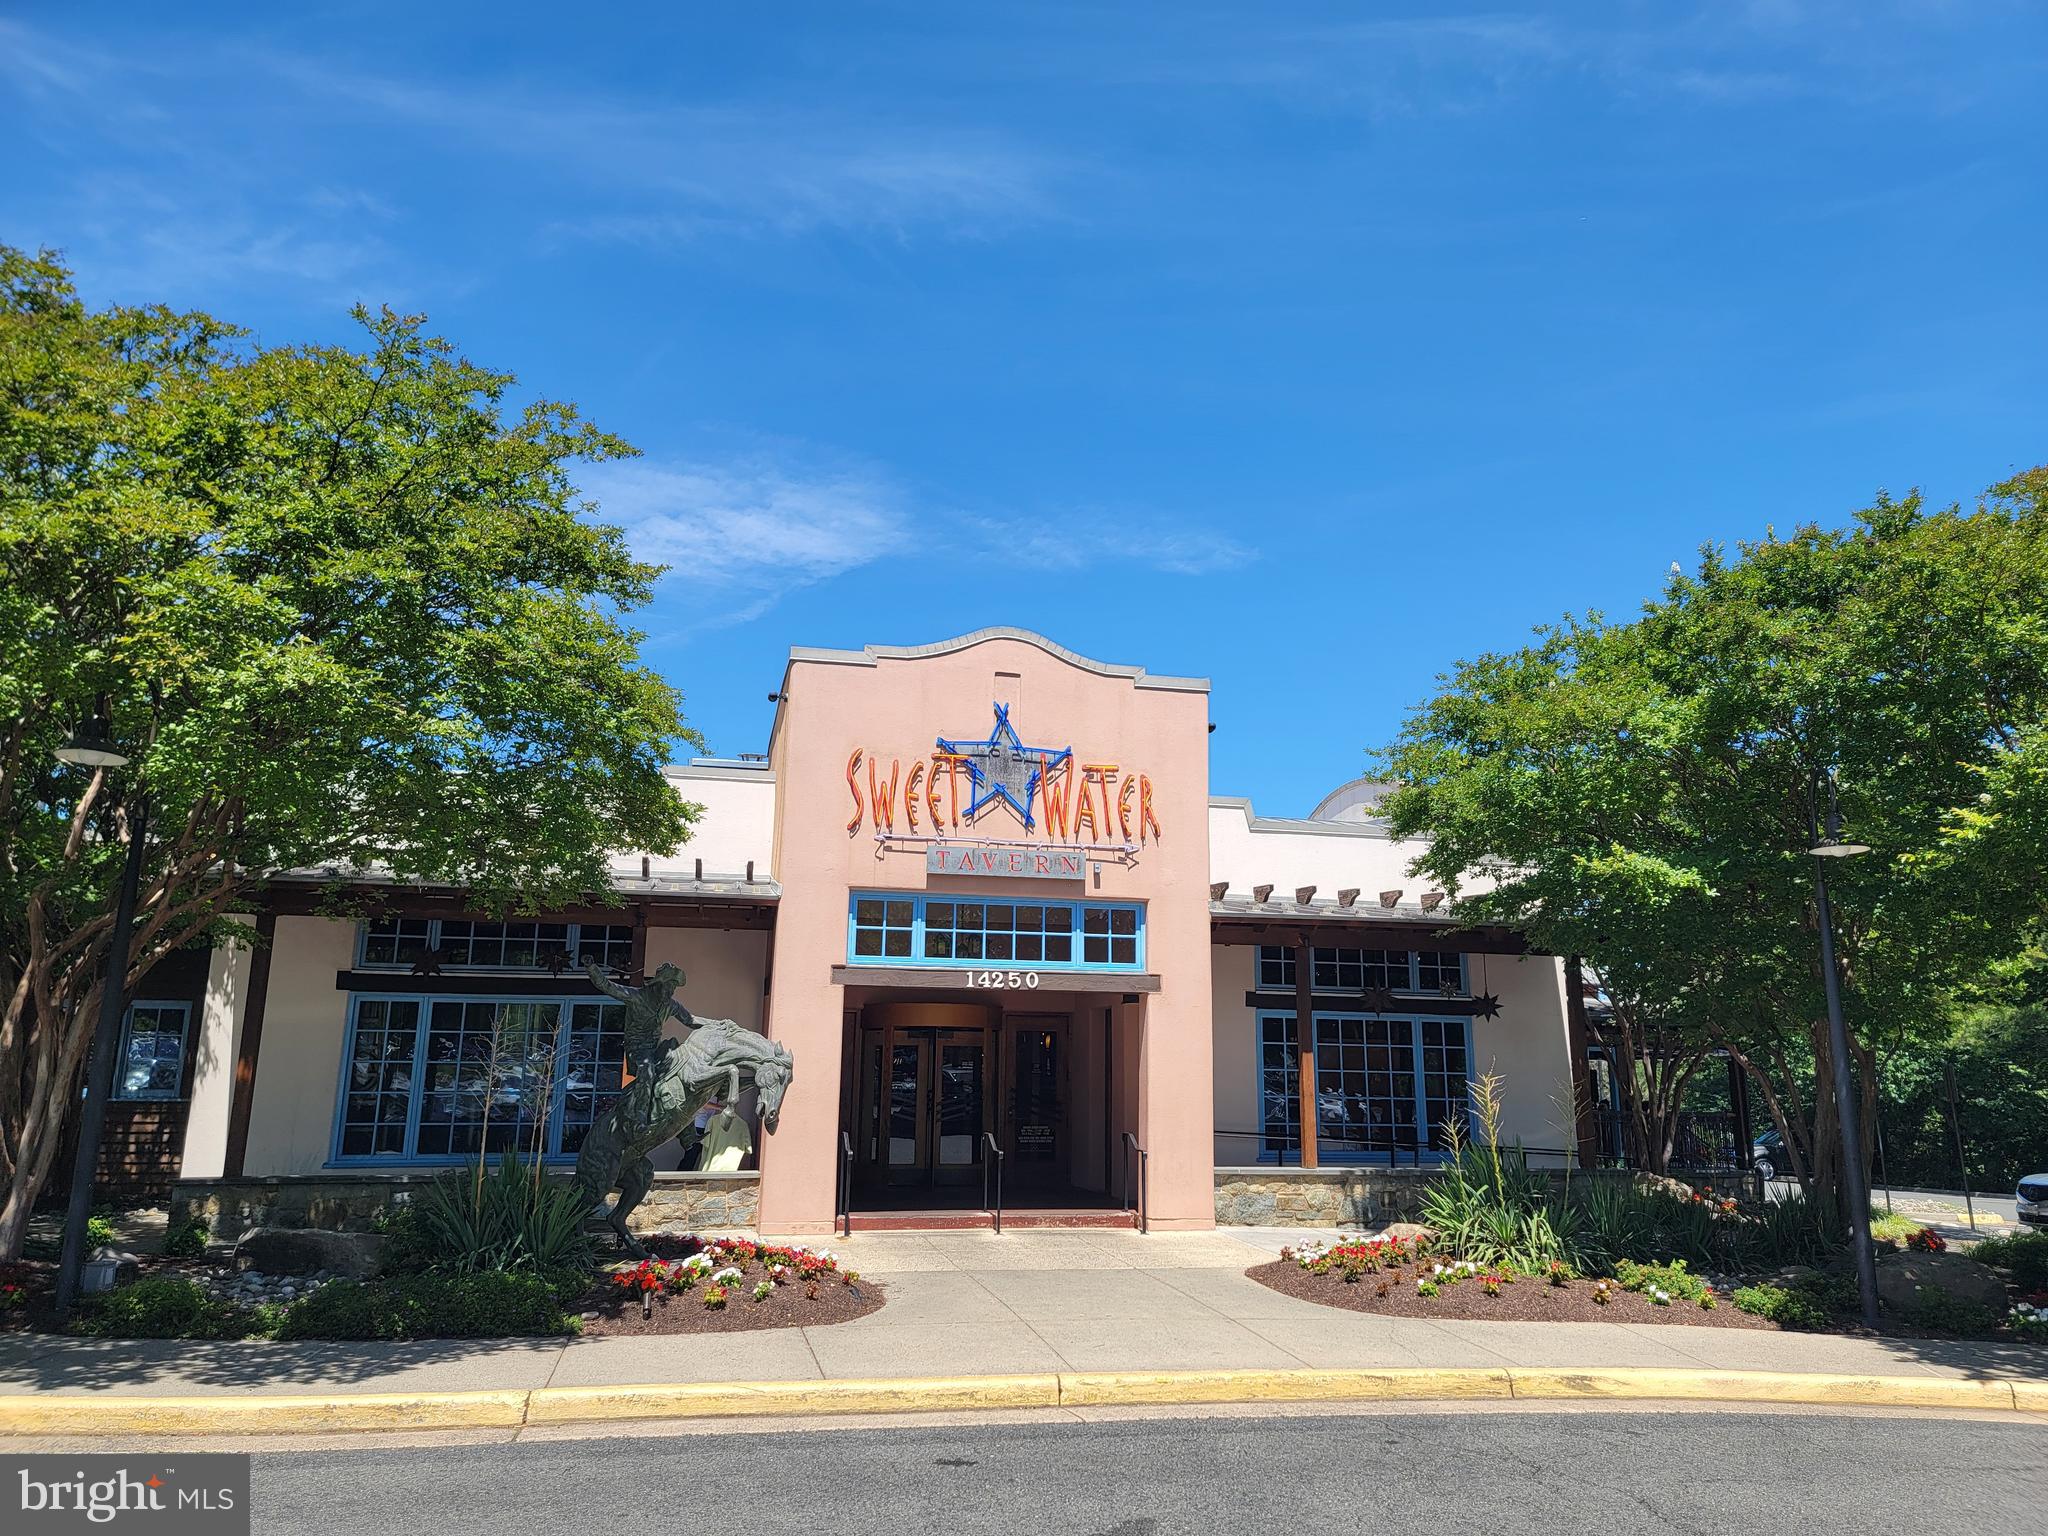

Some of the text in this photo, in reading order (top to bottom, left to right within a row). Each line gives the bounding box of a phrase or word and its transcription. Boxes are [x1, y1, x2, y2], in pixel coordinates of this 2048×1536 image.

[847, 748, 1161, 842] SWEET WATER
[935, 850, 1079, 875] TAVERN
[966, 971, 1039, 989] 14250
